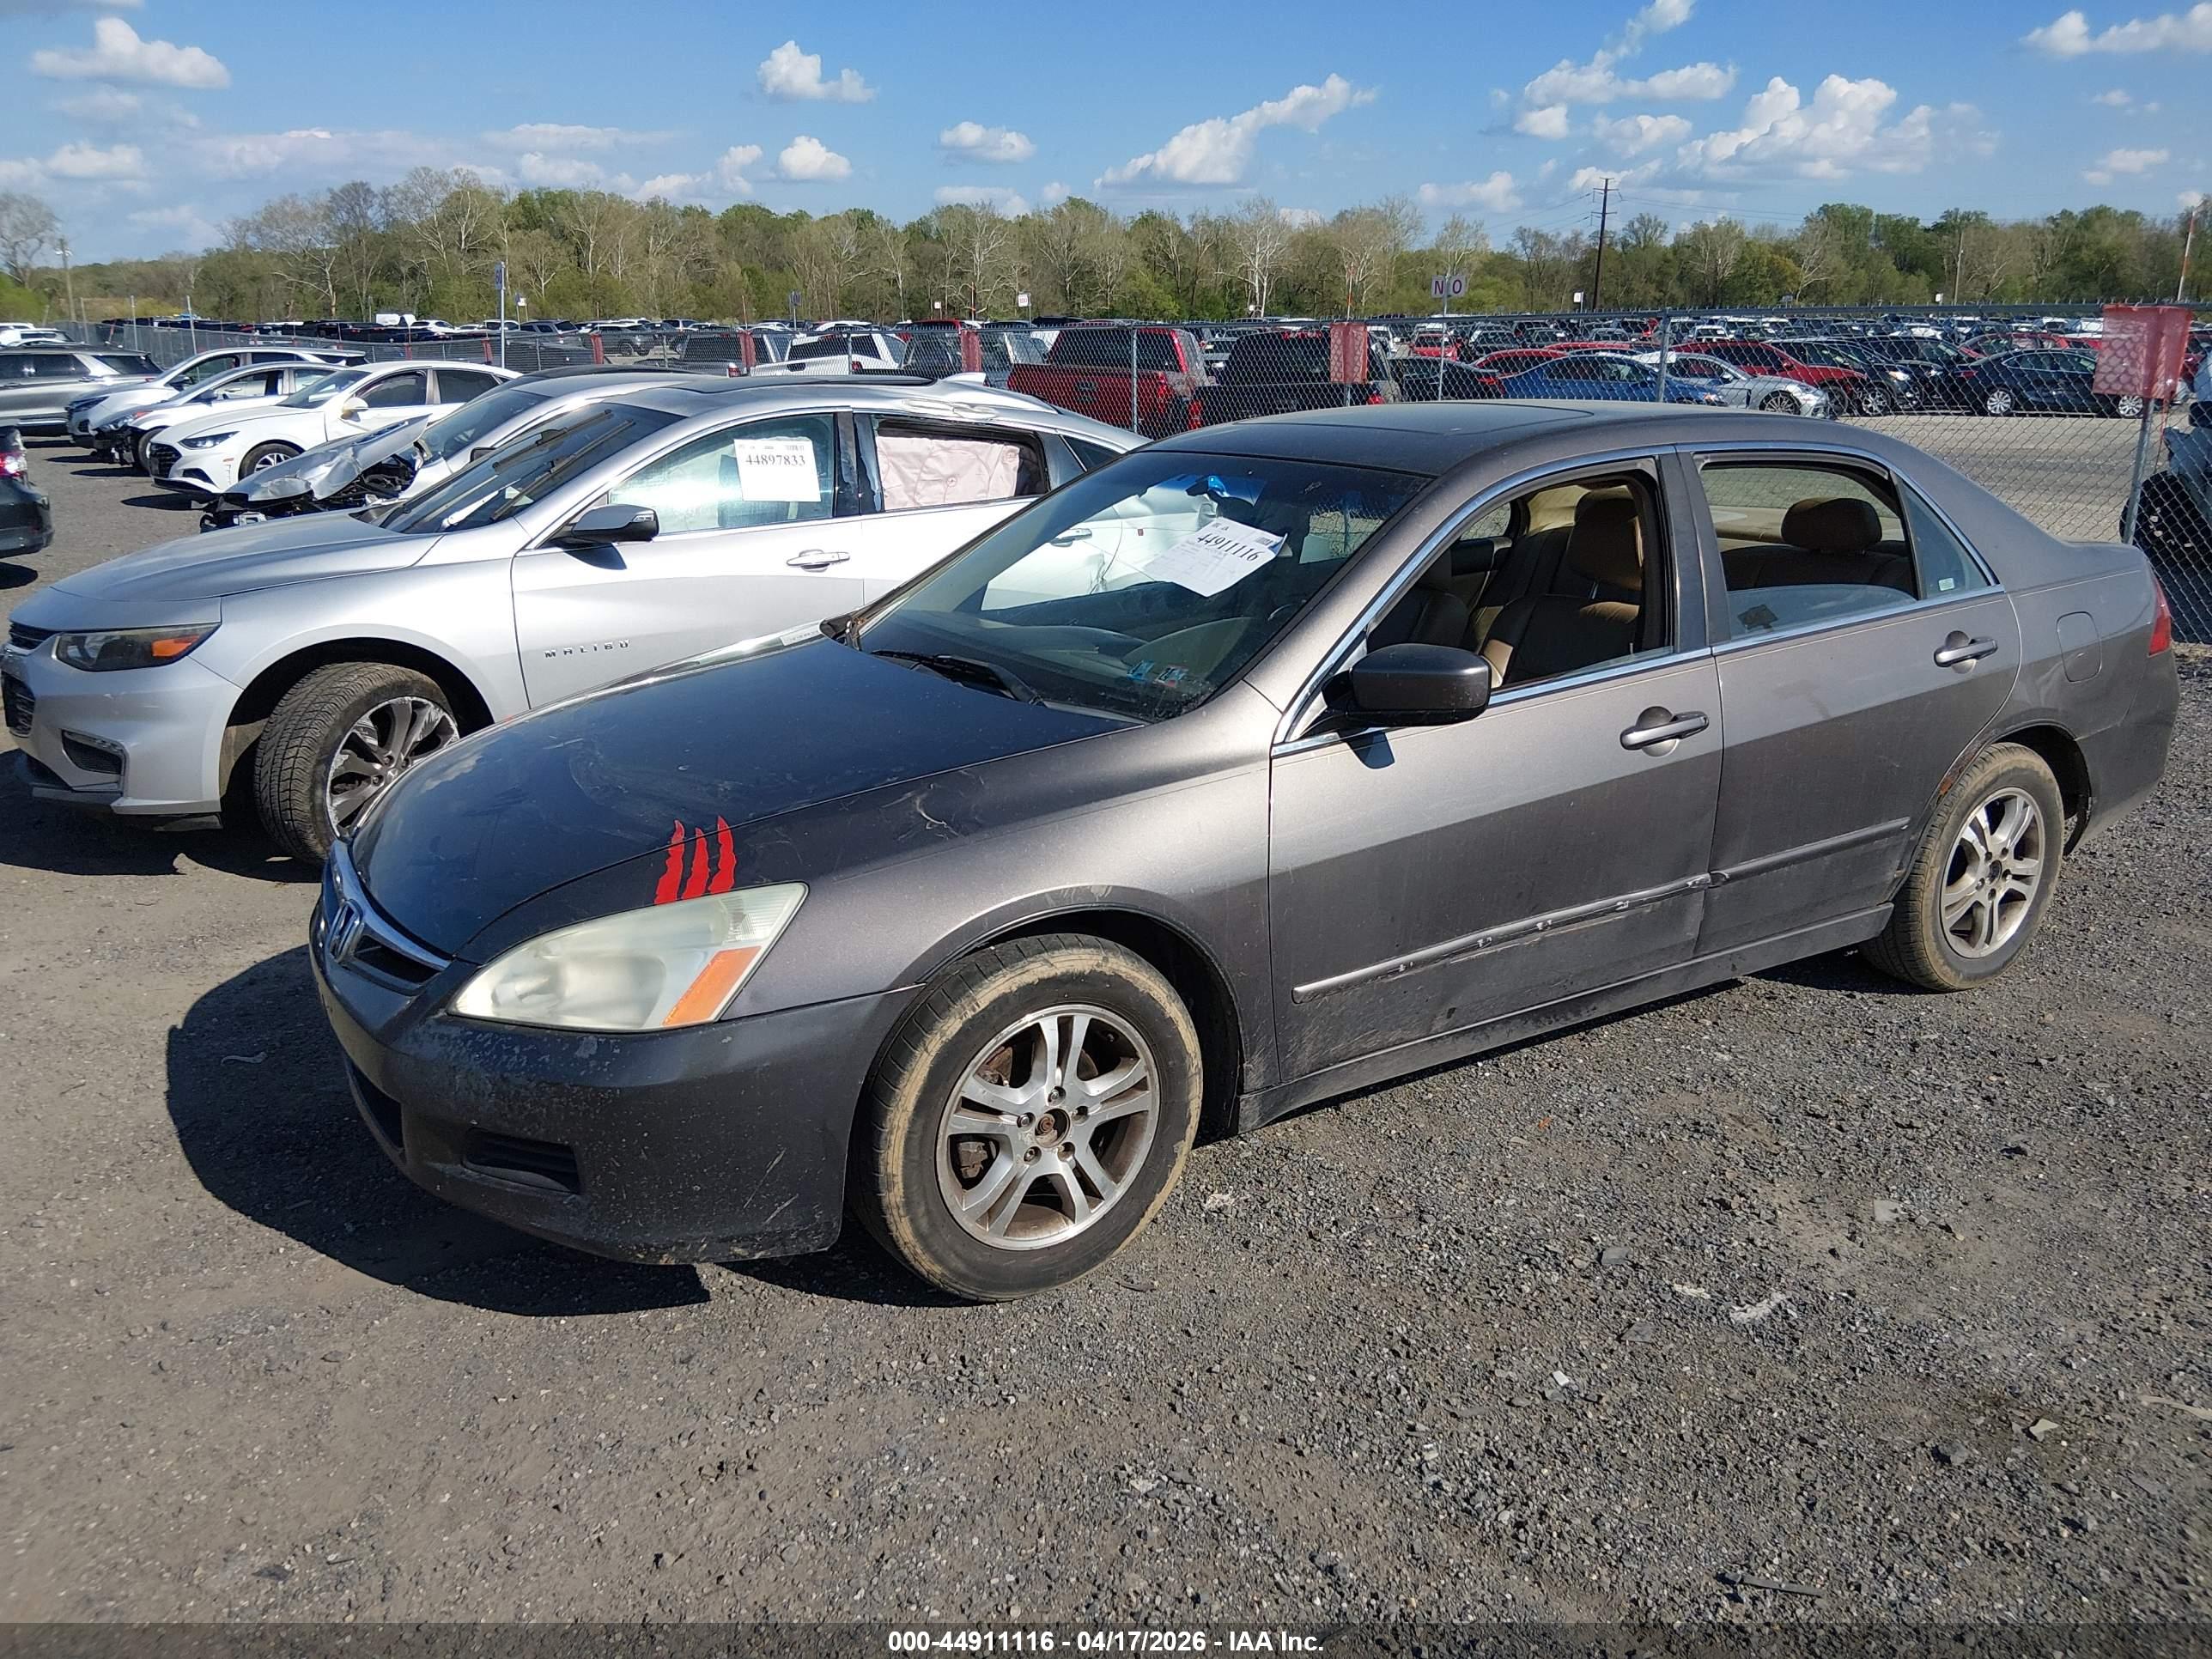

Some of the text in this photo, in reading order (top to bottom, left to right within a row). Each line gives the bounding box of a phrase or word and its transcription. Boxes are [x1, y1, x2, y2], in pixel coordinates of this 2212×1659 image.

[1434, 280, 1444, 295] N
[745, 454, 805, 466] 44897833
[1197, 532, 1264, 561] 44911116
[544, 640, 629, 658] MALIBU
